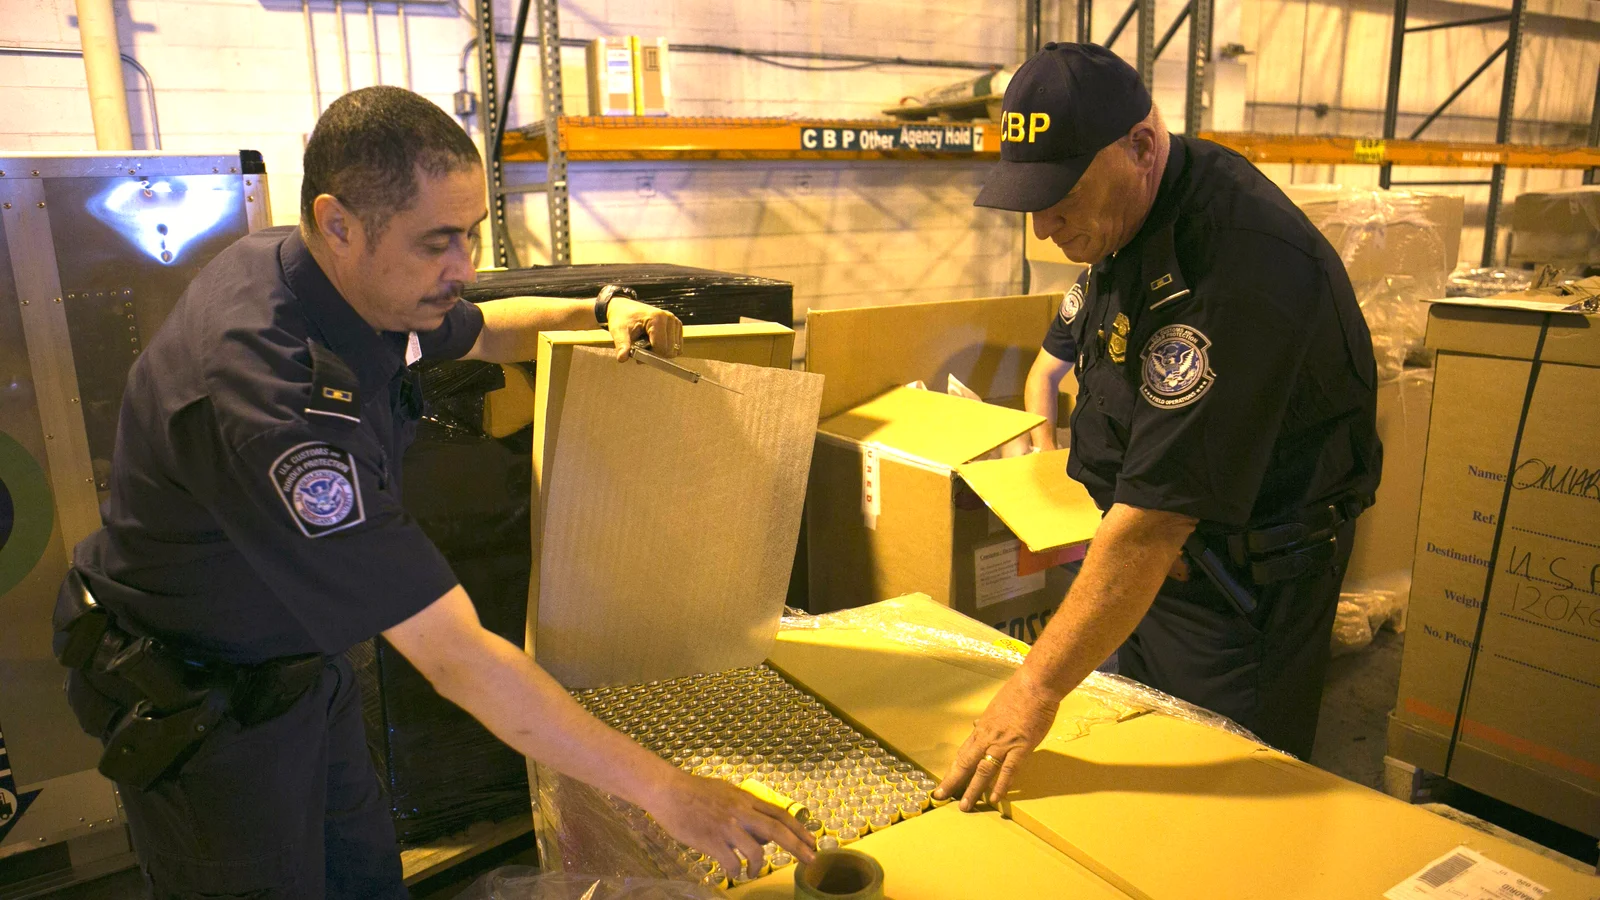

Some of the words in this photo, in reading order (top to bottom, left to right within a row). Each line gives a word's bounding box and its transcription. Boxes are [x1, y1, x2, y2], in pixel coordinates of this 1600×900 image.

[1001, 110, 1051, 143] CBP
[859, 130, 895, 149] Other
[900, 125, 943, 149] Agency
[944, 125, 972, 146] Hold
[1166, 332, 1199, 344] PROTECTION
[1152, 395, 1165, 405] FIELD
[1165, 391, 1197, 405] OPERATIONS
[290, 447, 329, 464] CUSTOMS
[283, 465, 305, 492] BORDER
[303, 458, 350, 473] PROTECTION
[1468, 464, 1507, 482] Name:
[1472, 510, 1496, 525] Ref.
[1423, 624, 1442, 640] No.
